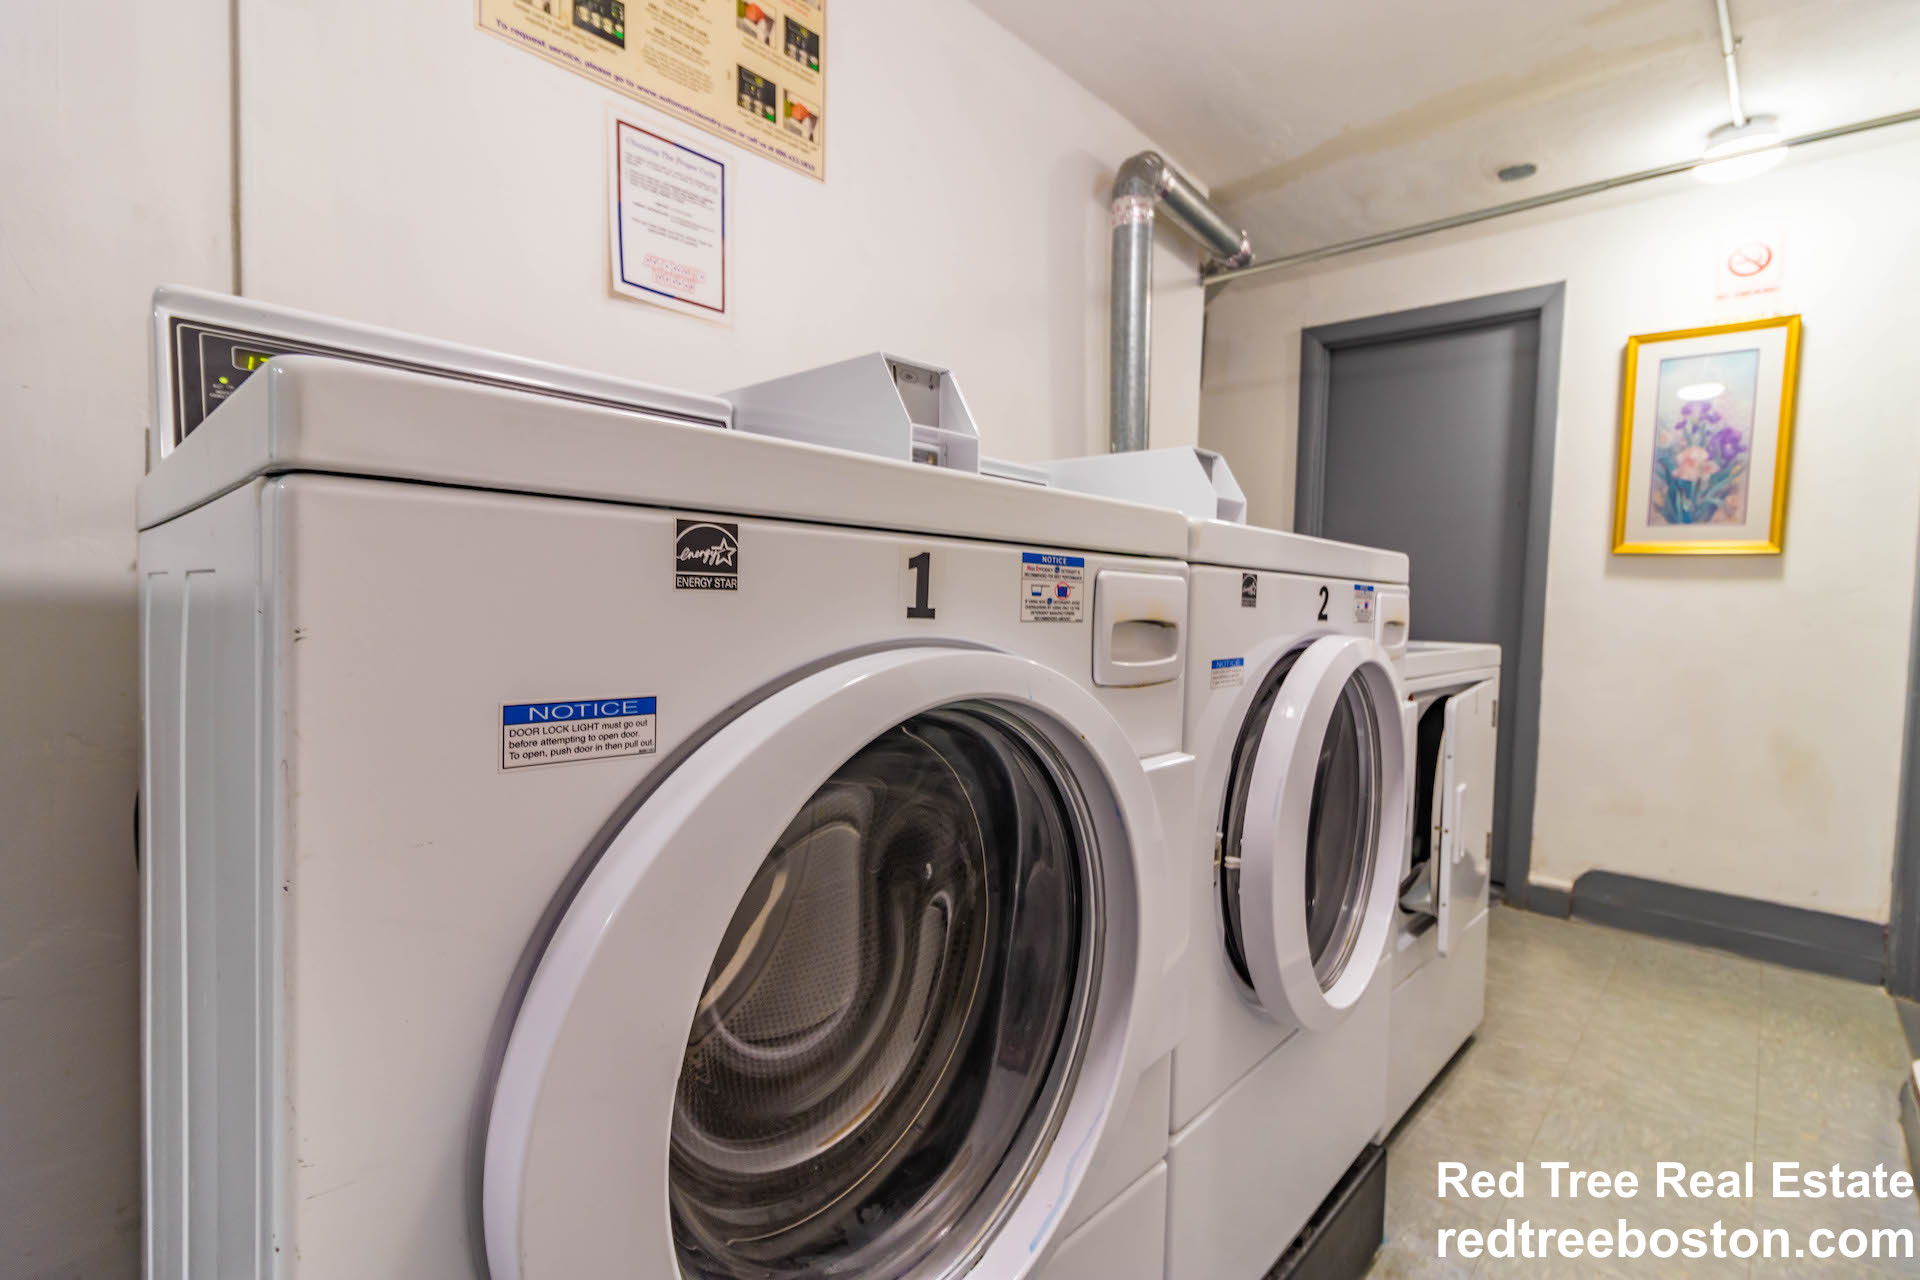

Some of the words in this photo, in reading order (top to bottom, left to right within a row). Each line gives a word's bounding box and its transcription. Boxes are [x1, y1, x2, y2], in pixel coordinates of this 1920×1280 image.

[496, 18, 508, 31] To
[510, 27, 546, 47] request
[584, 60, 612, 78] please
[613, 74, 625, 83] go
[626, 79, 635, 87] to
[1042, 556, 1067, 565] NOTICE
[676, 576, 713, 588] ENERGY
[714, 577, 738, 589] STAR
[907, 552, 935, 619] 1
[1318, 585, 1329, 621] 2
[1216, 659, 1242, 668] NOTICE
[529, 701, 638, 721] NOTICE
[509, 727, 540, 738] DOOR
[542, 725, 569, 735] LOCK
[571, 722, 599, 732] LIGHT
[602, 721, 621, 730] must
[624, 721, 633, 730] go
[635, 719, 648, 727] out
[509, 739, 538, 749] before
[540, 734, 586, 745] attempting
[598, 732, 619, 742] open
[621, 730, 640, 739] door.
[509, 751, 520, 760] To
[522, 749, 548, 760] open,
[550, 746, 572, 757] push
[574, 745, 593, 754] door
[595, 743, 603, 751] in
[605, 742, 623, 750] then
[624, 740, 639, 750] pull
